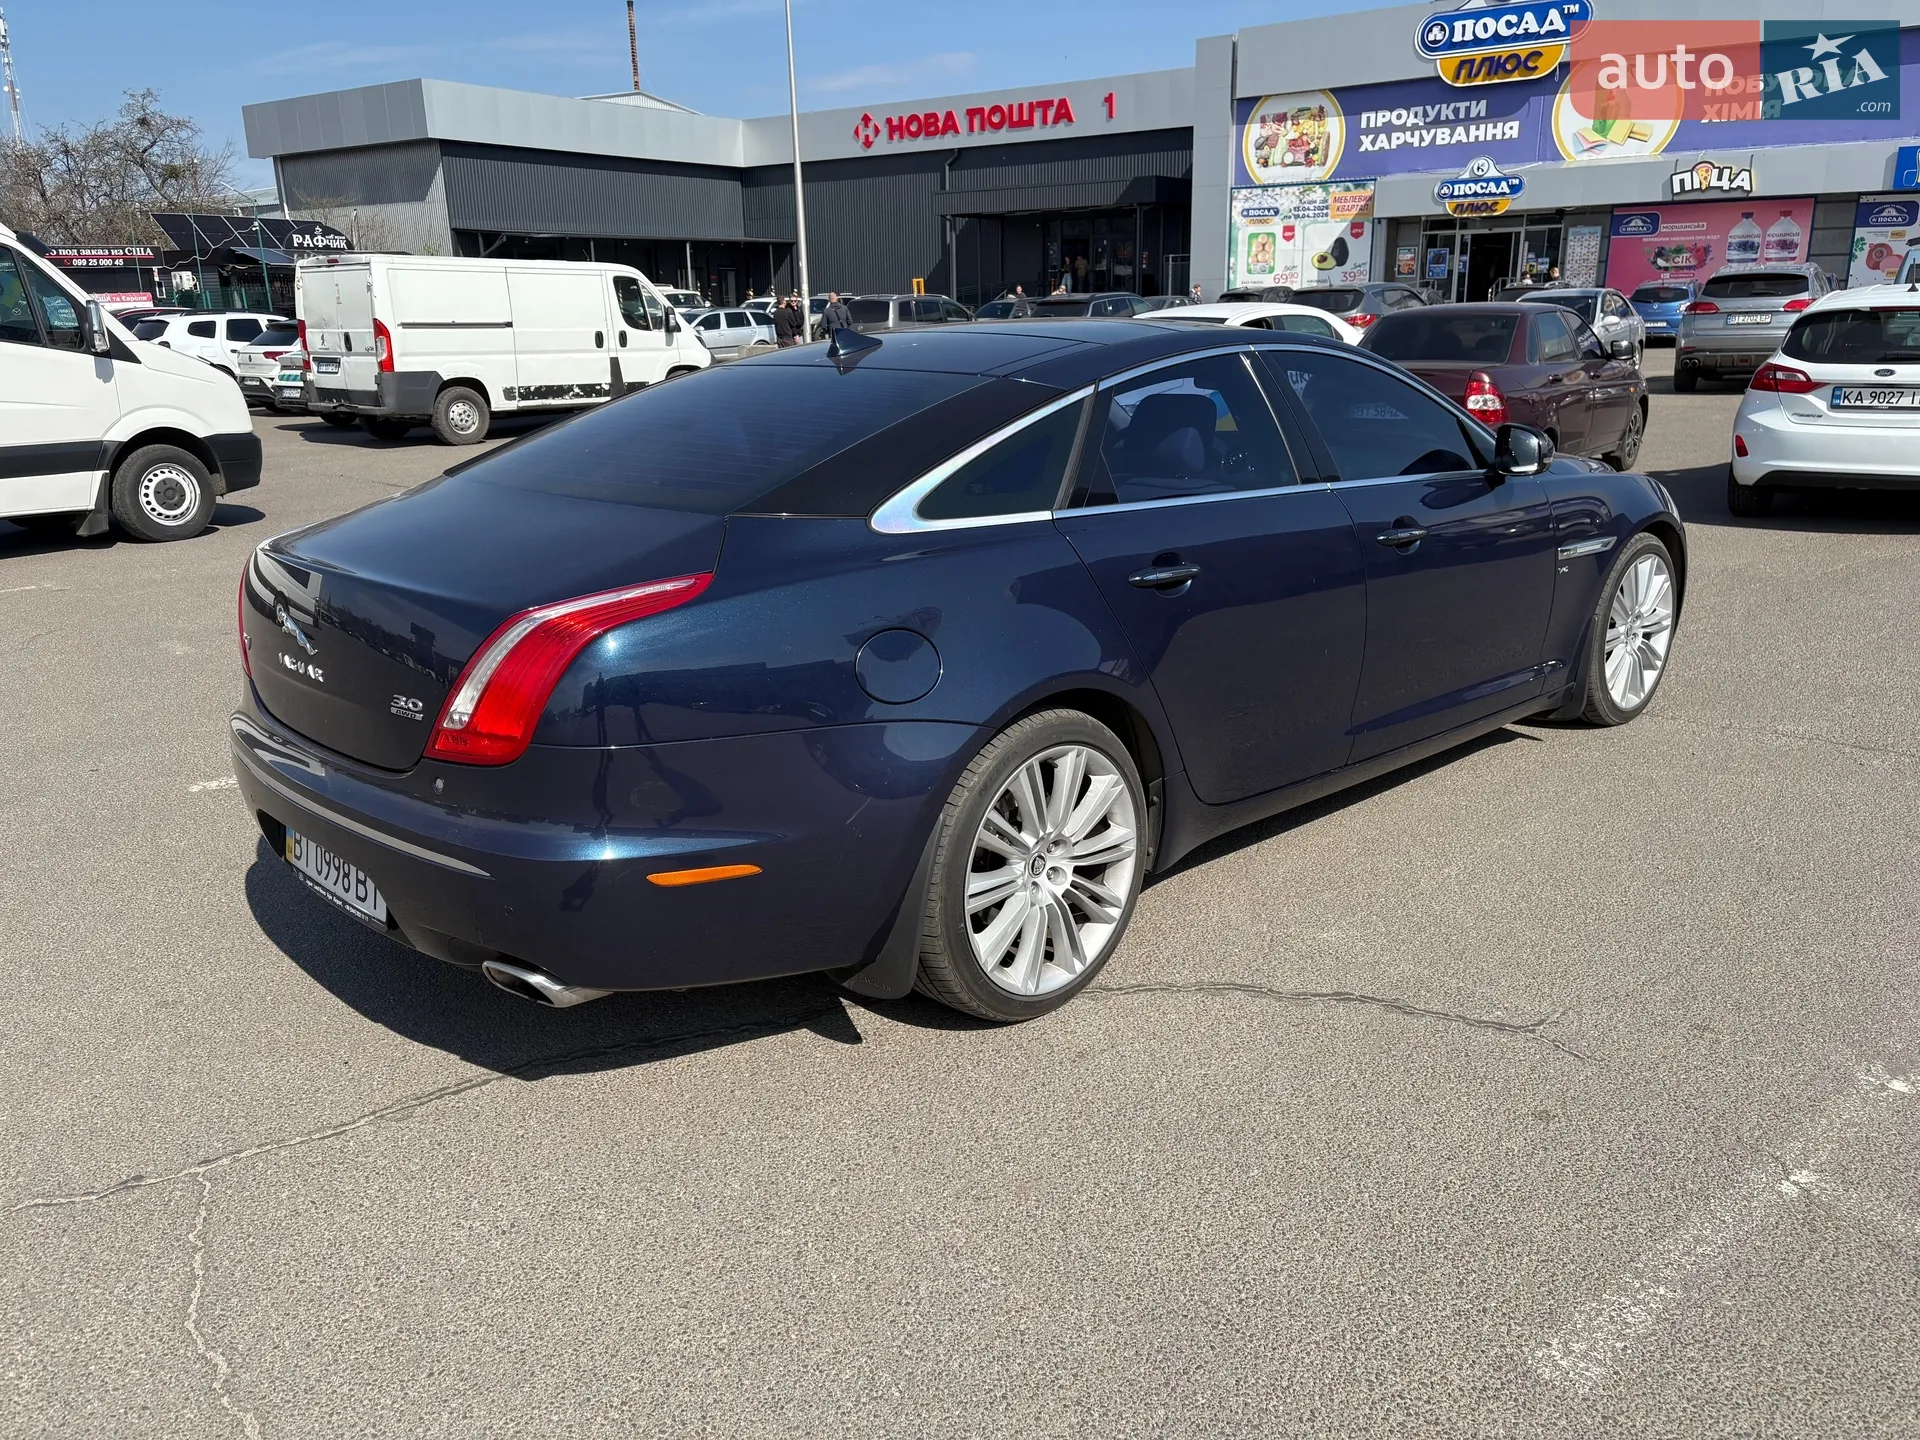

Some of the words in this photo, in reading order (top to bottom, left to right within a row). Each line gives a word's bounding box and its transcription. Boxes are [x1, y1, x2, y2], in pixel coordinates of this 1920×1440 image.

[1452, 8, 1566, 42] ПОСАД
[1455, 51, 1544, 81] ПЛЮС
[885, 110, 961, 141] НОВА
[966, 98, 1075, 133] ПОШТА
[1104, 92, 1116, 119] 1
[1360, 100, 1487, 129] ПРОДУКТИ
[1701, 100, 1783, 123] ХІМІЯ
[1358, 121, 1520, 152] ХАРЧУВАННЯ
[1453, 181, 1510, 196] ПОСАД
[1672, 166, 1751, 194] ПІЦА
[1454, 202, 1500, 214] ПЛЮС
[80, 248, 110, 256] заказ
[111, 248, 123, 256] из
[124, 247, 154, 256] США
[1843, 391, 1863, 404] KA
[1869, 391, 1904, 404] 9027
[315, 845, 350, 893] 0998
